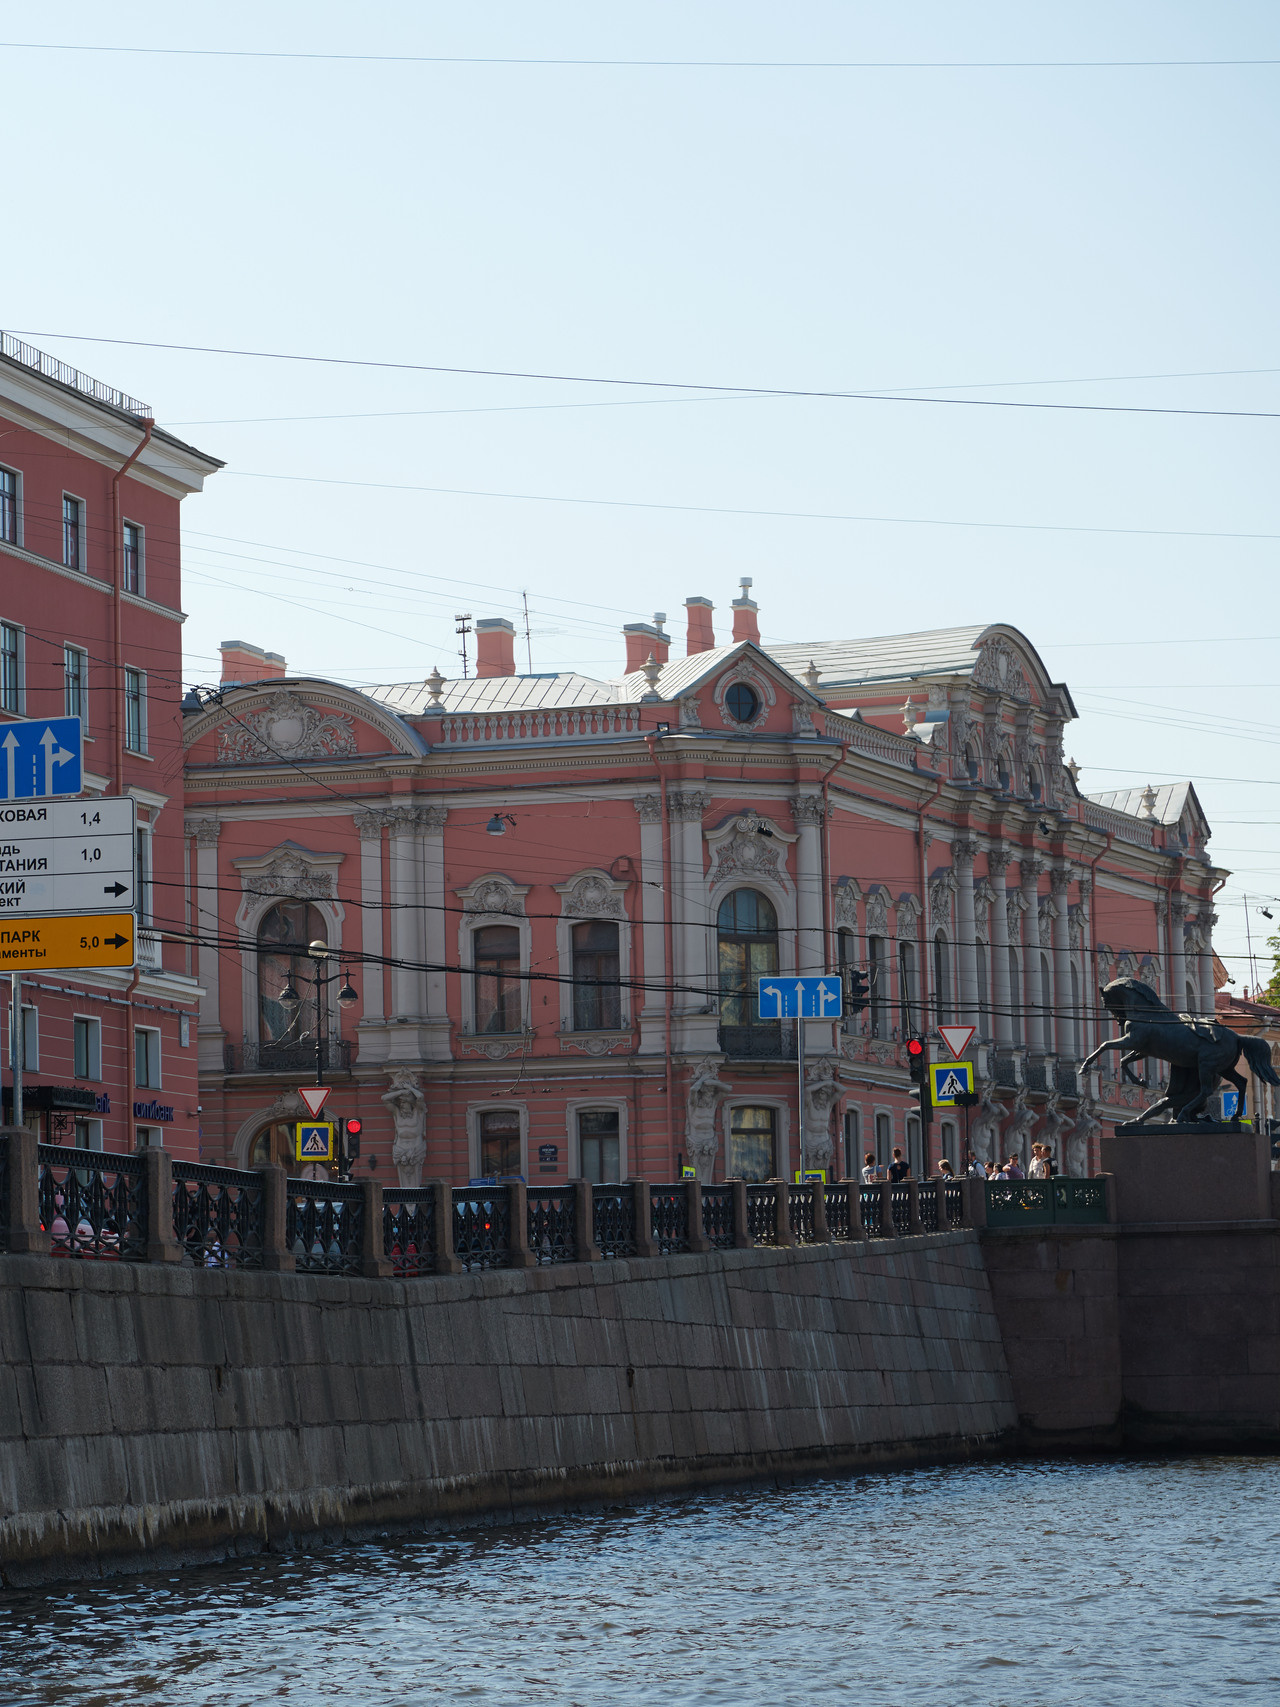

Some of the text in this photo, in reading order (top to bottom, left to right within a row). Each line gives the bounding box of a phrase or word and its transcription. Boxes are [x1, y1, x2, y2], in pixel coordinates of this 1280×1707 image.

[80, 811, 101, 827] 1,4
[81, 848, 102, 863] 1,0
[0, 930, 40, 944] ПАРК
[80, 936, 100, 951] 5,0
[134, 1100, 174, 1121] ситибанк
